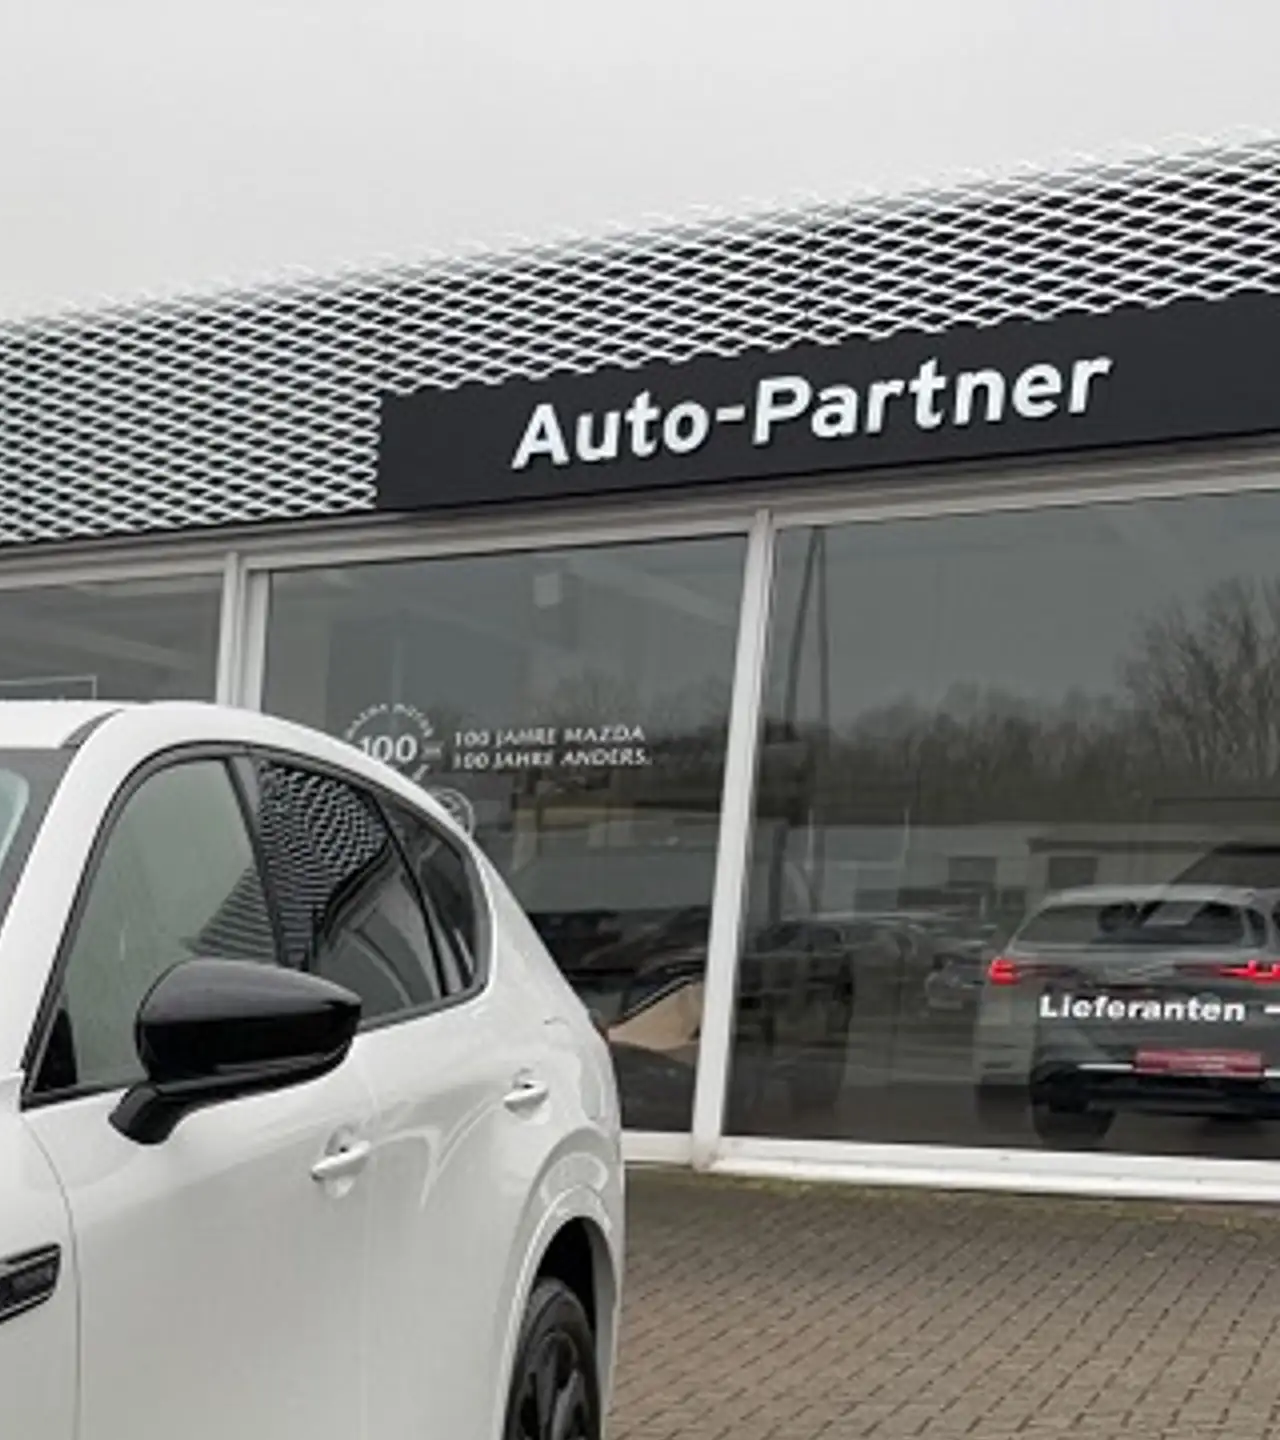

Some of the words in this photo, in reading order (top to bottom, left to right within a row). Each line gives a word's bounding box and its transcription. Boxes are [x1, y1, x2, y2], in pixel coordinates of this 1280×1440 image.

[511, 356, 1111, 469] Auto-Partner
[454, 730, 490, 748] 100
[496, 727, 558, 748] JAHRE
[564, 724, 646, 743] MAZDA
[453, 750, 489, 770] 100
[492, 750, 553, 770] JAHRE
[1039, 994, 1246, 1022] Lieferanten
